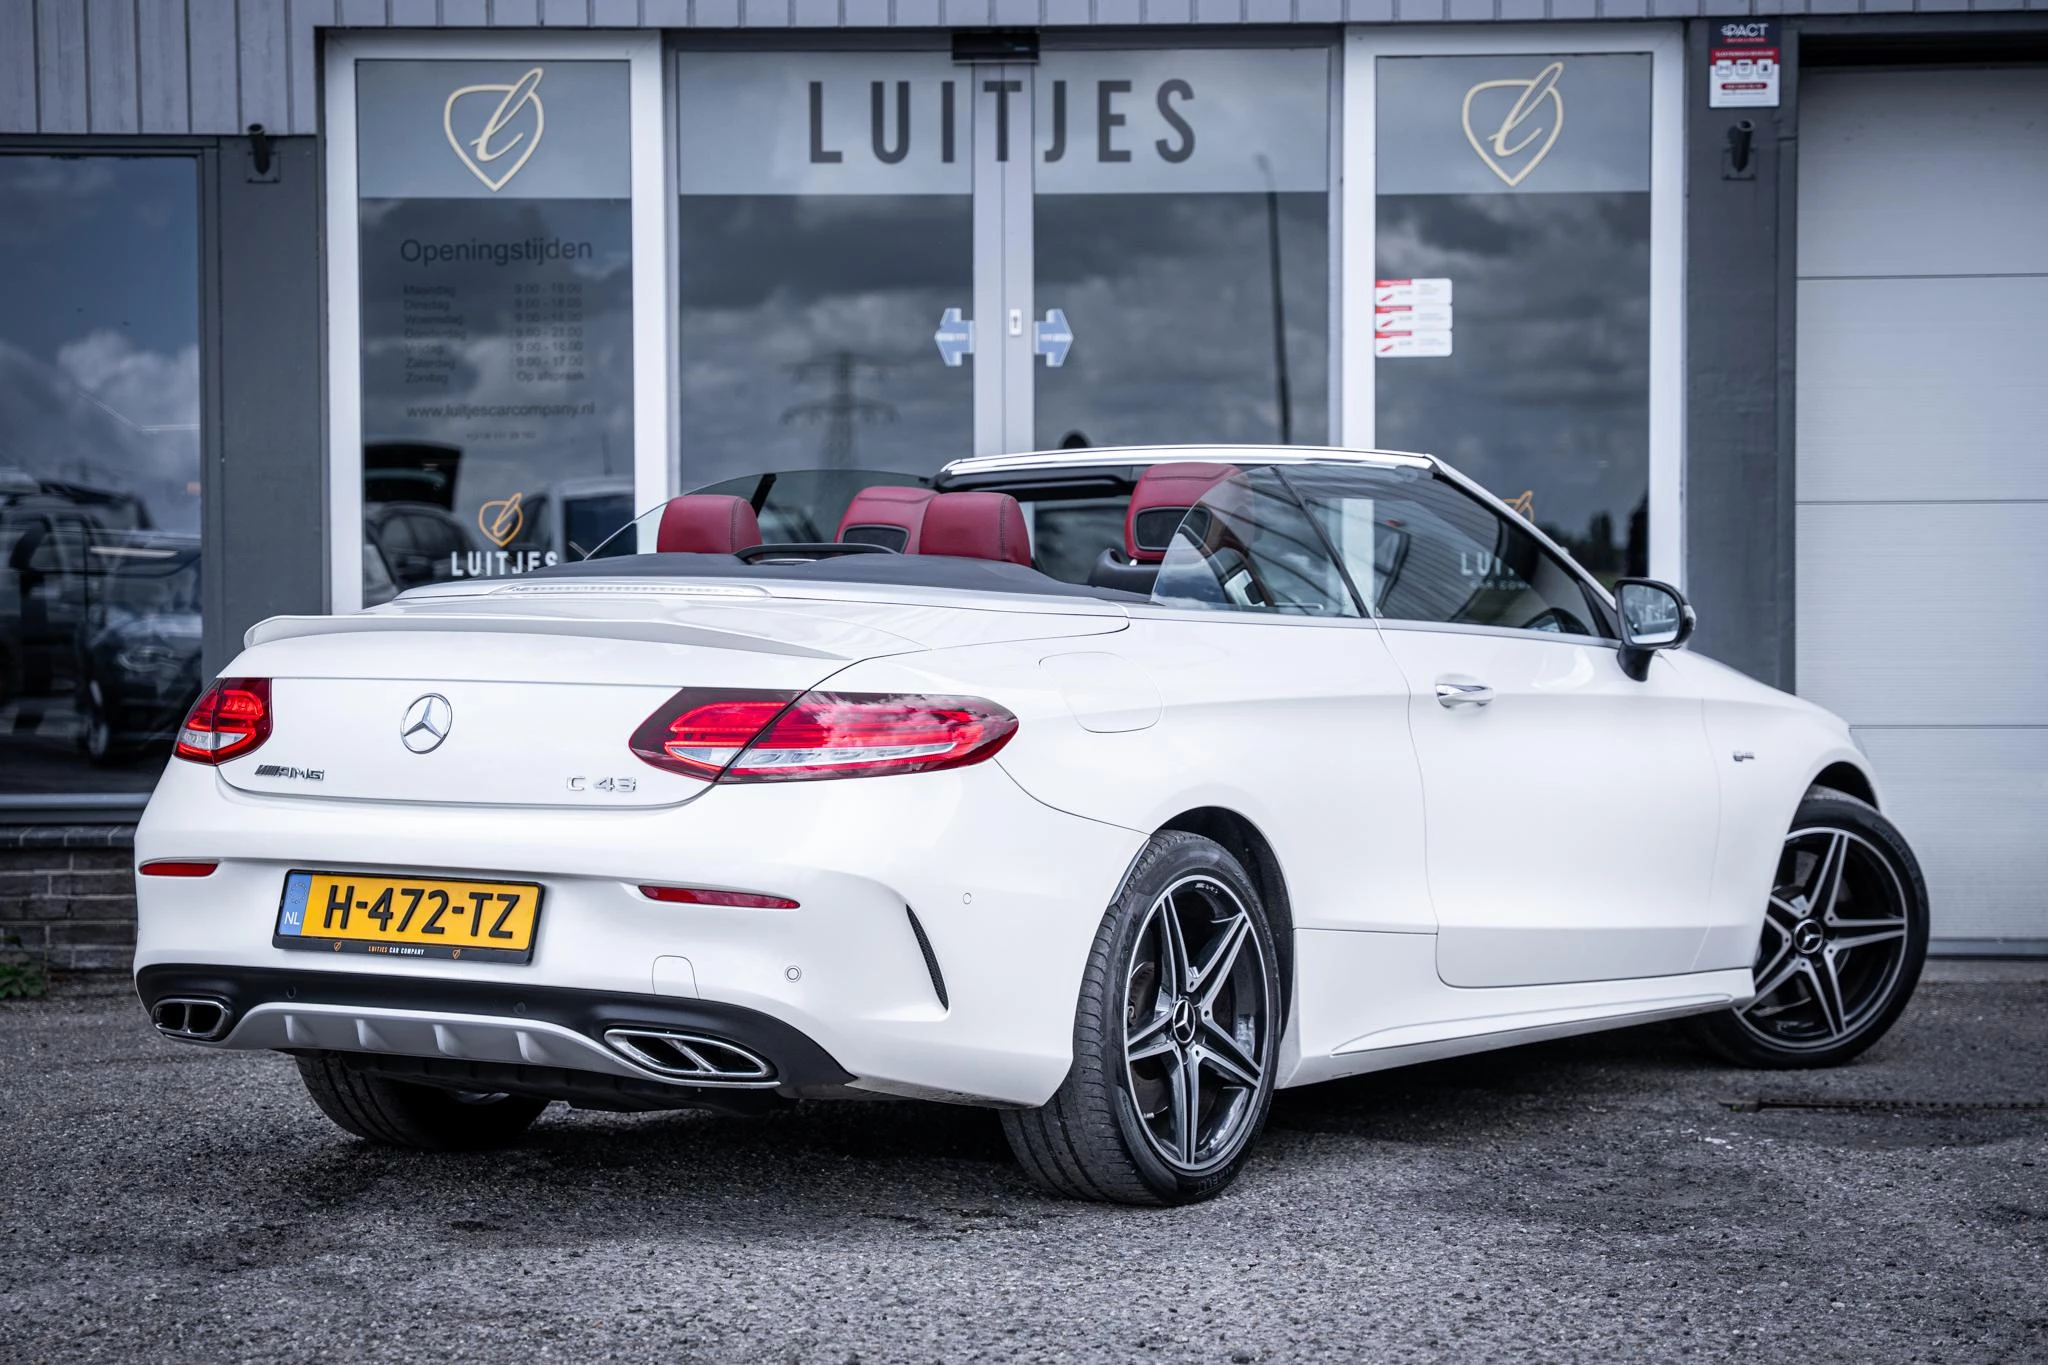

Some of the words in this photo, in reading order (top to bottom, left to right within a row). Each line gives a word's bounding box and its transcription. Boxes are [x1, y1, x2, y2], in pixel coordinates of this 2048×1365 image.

[808, 78, 1196, 164] LUITJES
[400, 238, 593, 266] Openingstijden
[406, 402, 595, 420] www.luitjescarcompany.nl
[278, 765, 325, 782] AMG
[566, 775, 586, 791] C
[592, 776, 637, 793] 43
[284, 911, 300, 926] NL
[323, 885, 521, 939] H-472-TZ
[388, 946, 400, 954] CAR
[400, 947, 425, 956] COMPANY
